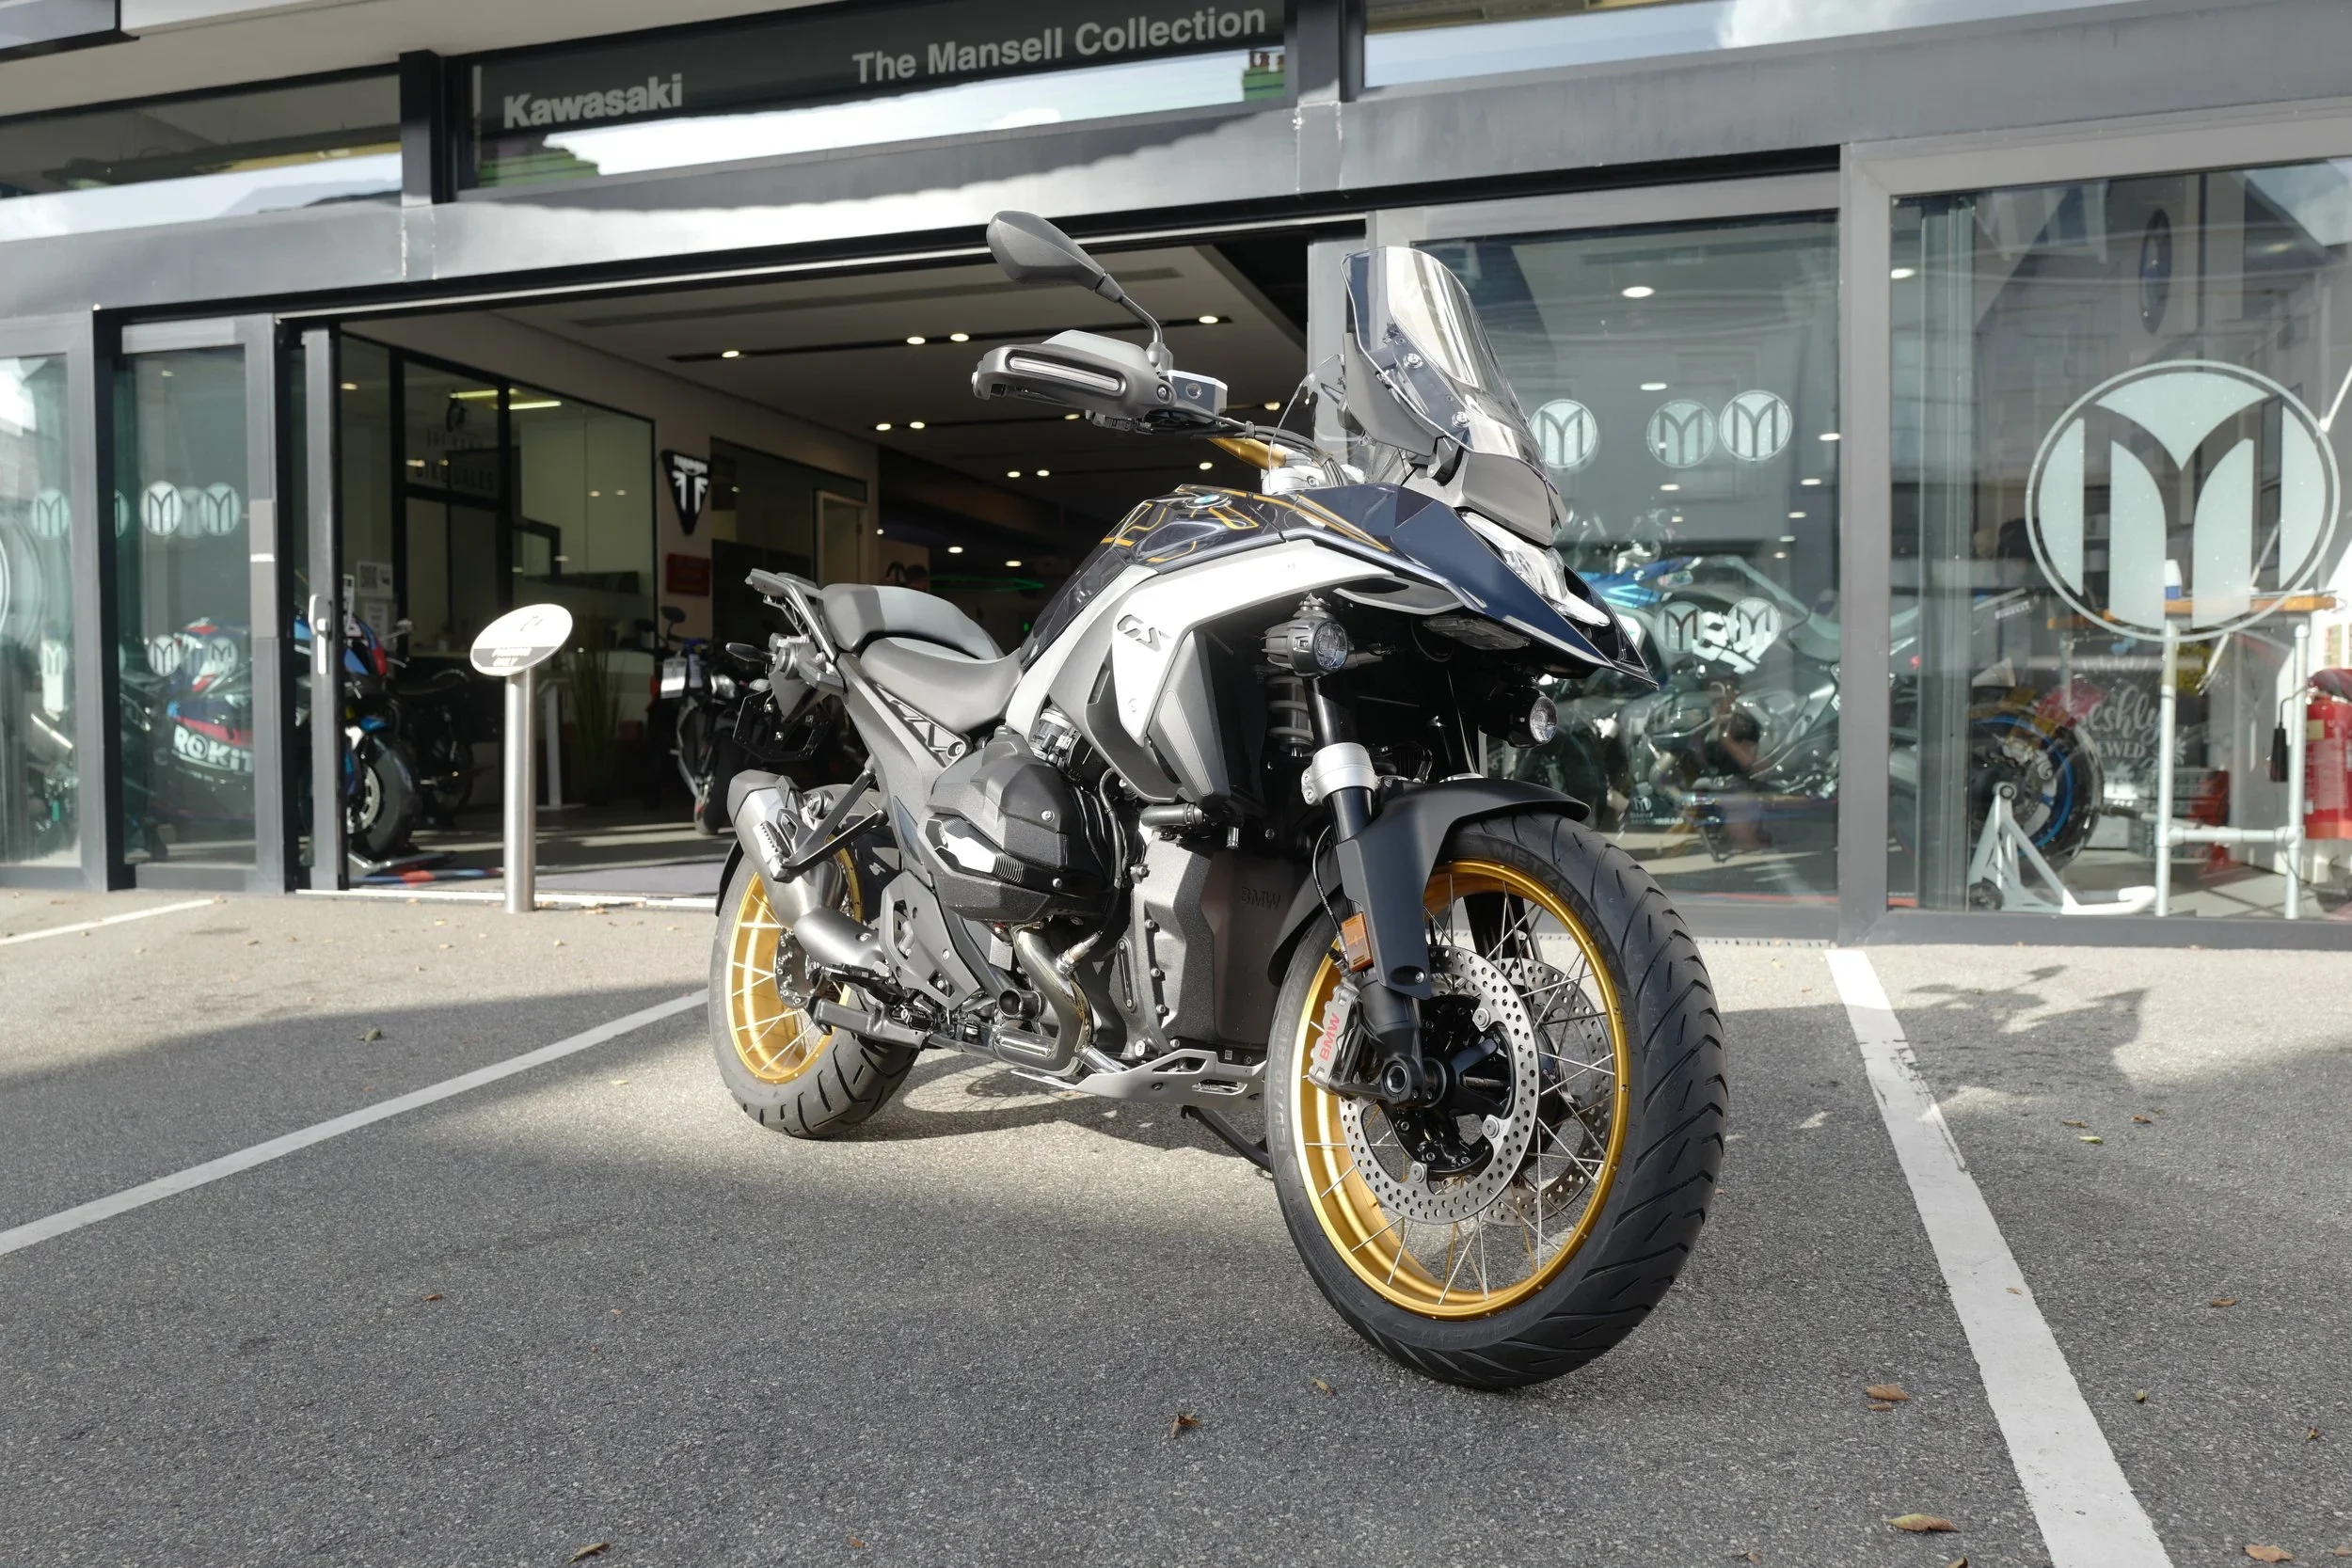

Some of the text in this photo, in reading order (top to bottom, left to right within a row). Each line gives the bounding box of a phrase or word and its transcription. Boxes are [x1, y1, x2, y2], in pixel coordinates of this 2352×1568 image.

[851, 7, 1267, 85] The Mansell Collection
[503, 72, 684, 129] Kawasaki
[1241, 886, 1282, 910] BMW
[1491, 842, 1609, 951] METZELER
[1319, 1012, 1342, 1062] BMW
